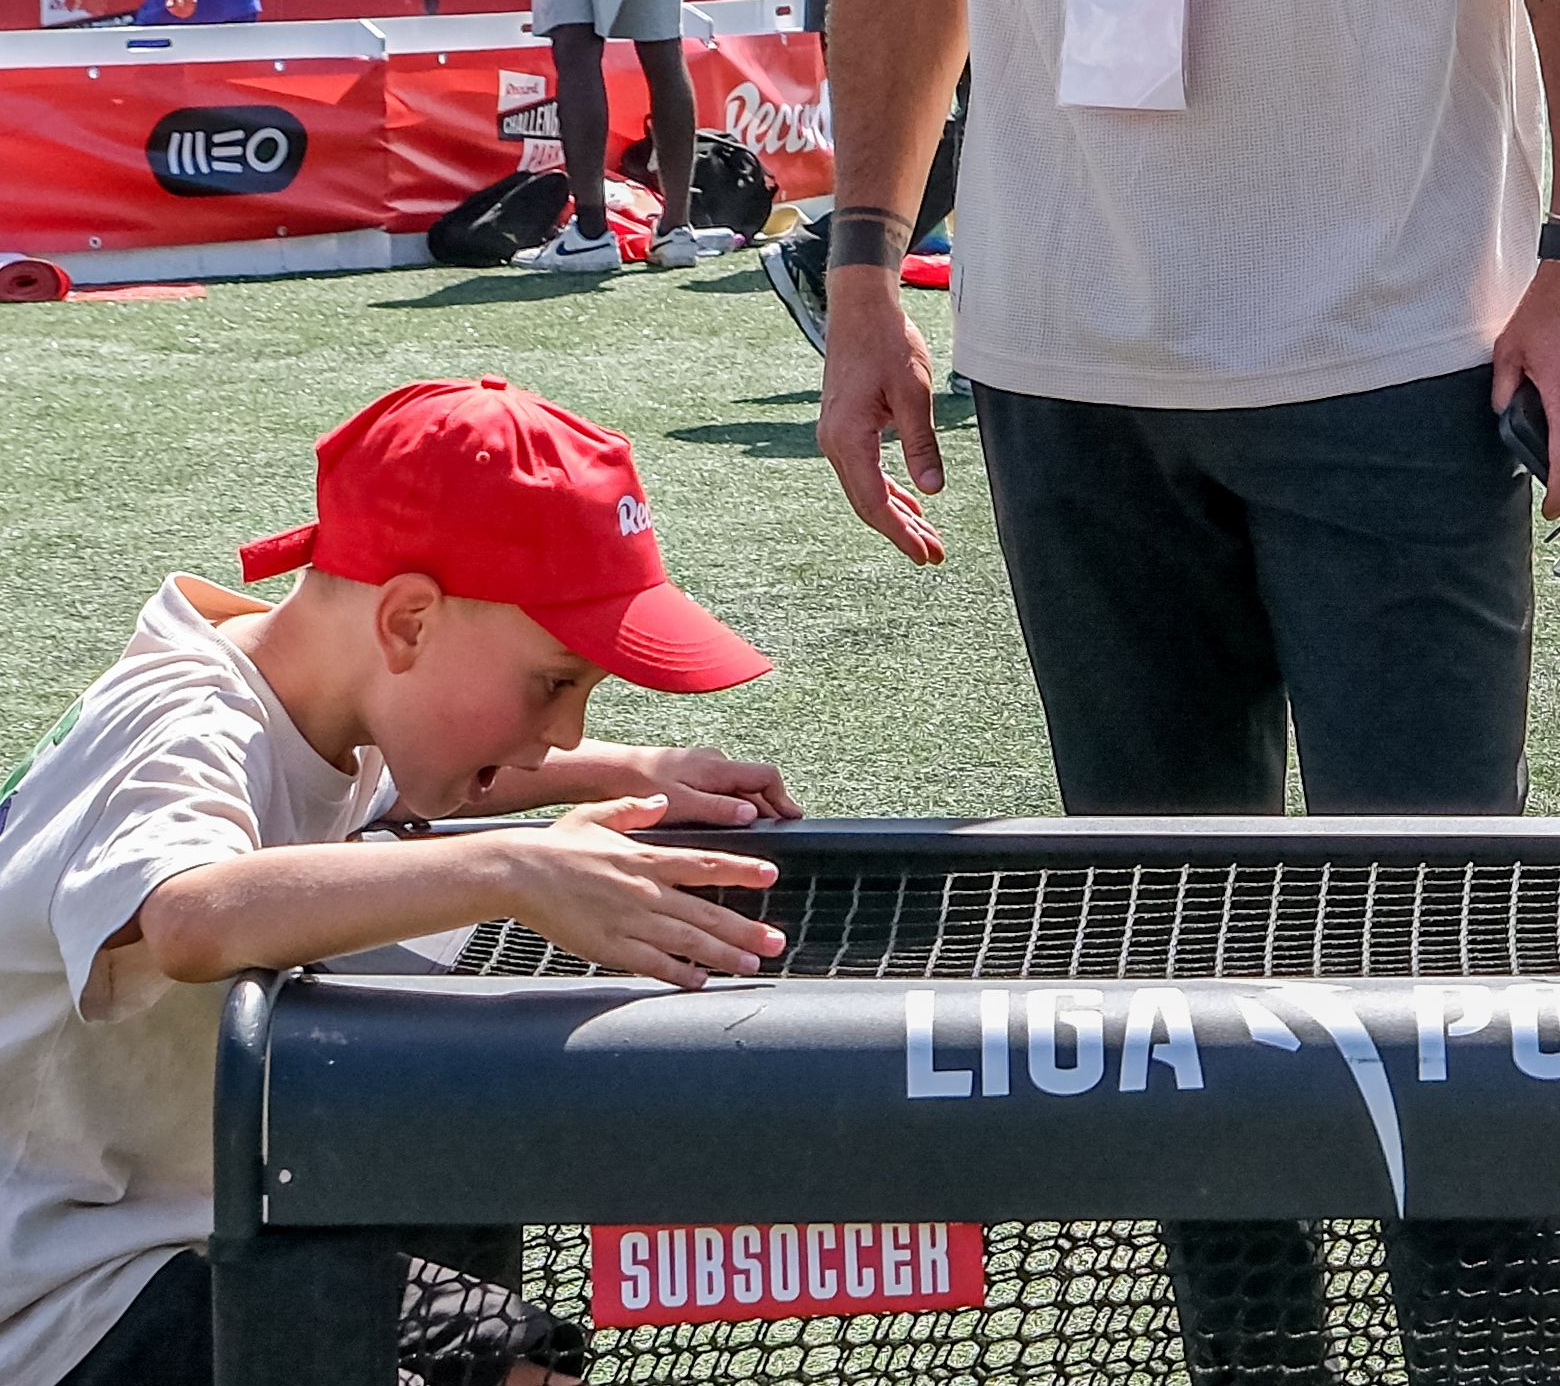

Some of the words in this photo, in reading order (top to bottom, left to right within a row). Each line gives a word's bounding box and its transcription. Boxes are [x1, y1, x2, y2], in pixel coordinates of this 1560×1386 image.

[165, 125, 290, 177] MEO
[904, 985, 1207, 1100] LIGA
[618, 1221, 952, 1310] SUBSOCCER
